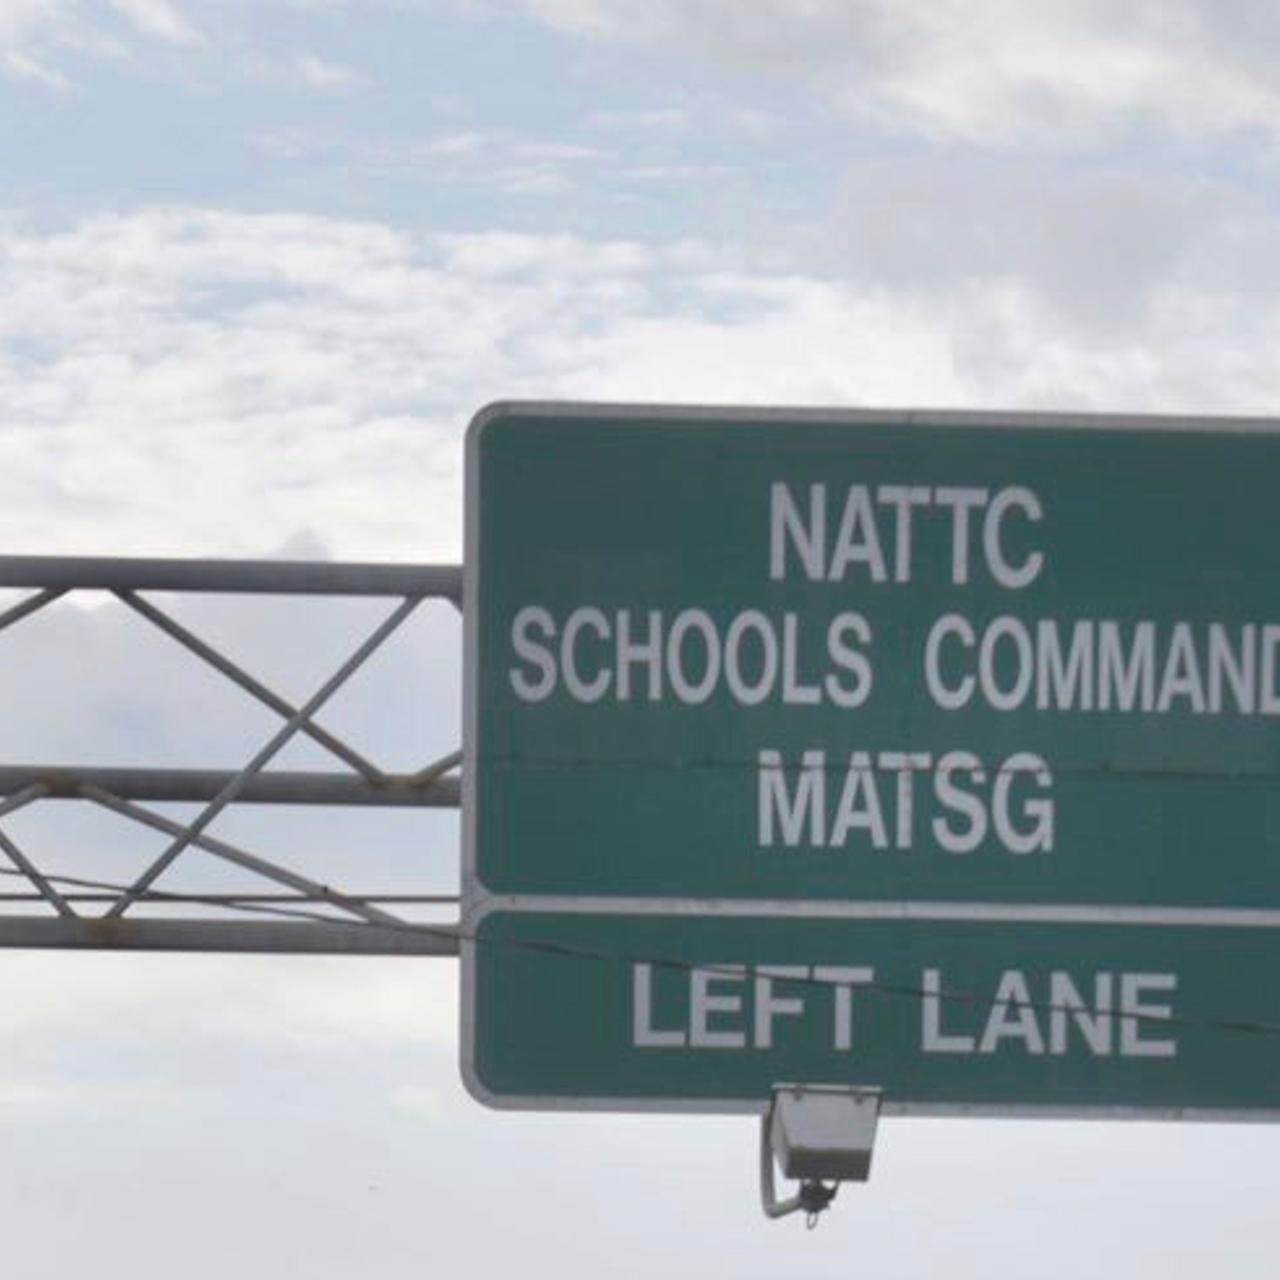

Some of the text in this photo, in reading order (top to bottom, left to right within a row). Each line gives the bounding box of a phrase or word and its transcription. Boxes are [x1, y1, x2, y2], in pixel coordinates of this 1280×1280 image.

[769, 482, 1044, 589] NATTC
[509, 606, 874, 708] SCHOOLS
[756, 749, 1054, 854] MATSG
[632, 963, 1178, 1057] LEFT LANE
